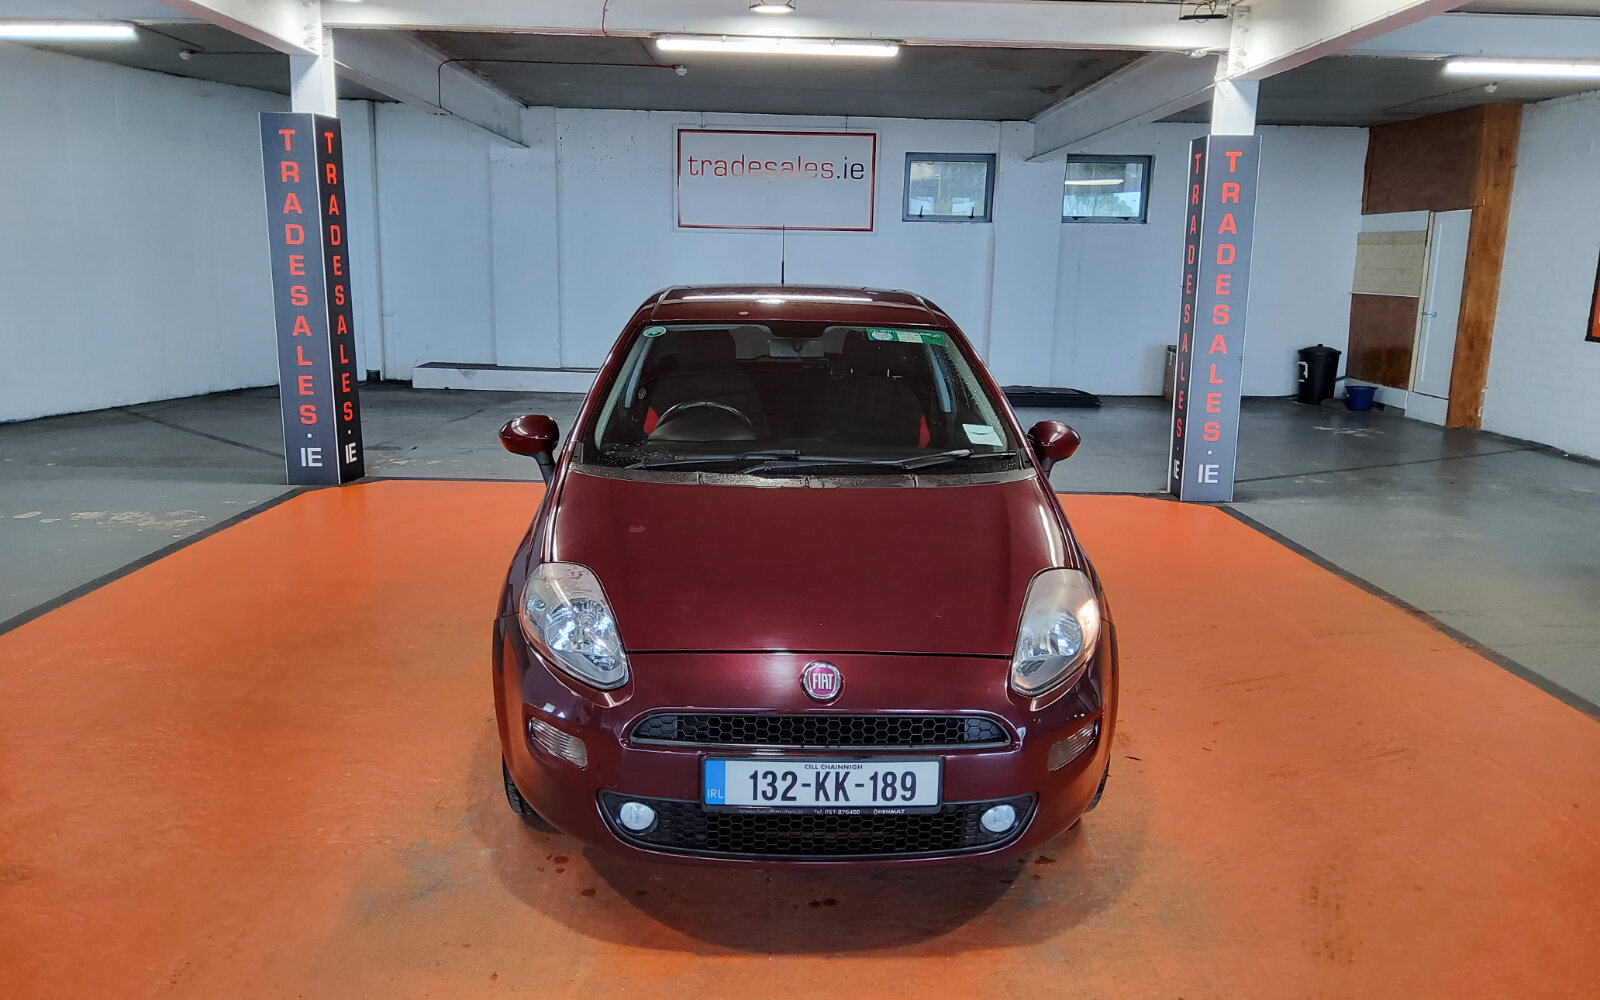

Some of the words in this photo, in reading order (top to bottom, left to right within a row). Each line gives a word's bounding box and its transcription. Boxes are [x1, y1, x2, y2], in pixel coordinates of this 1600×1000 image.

[687, 154, 865, 180] tradesales.ie
[812, 673, 834, 690] FIAT
[707, 788, 724, 799] IRL
[749, 770, 917, 802] 132-KK-189
